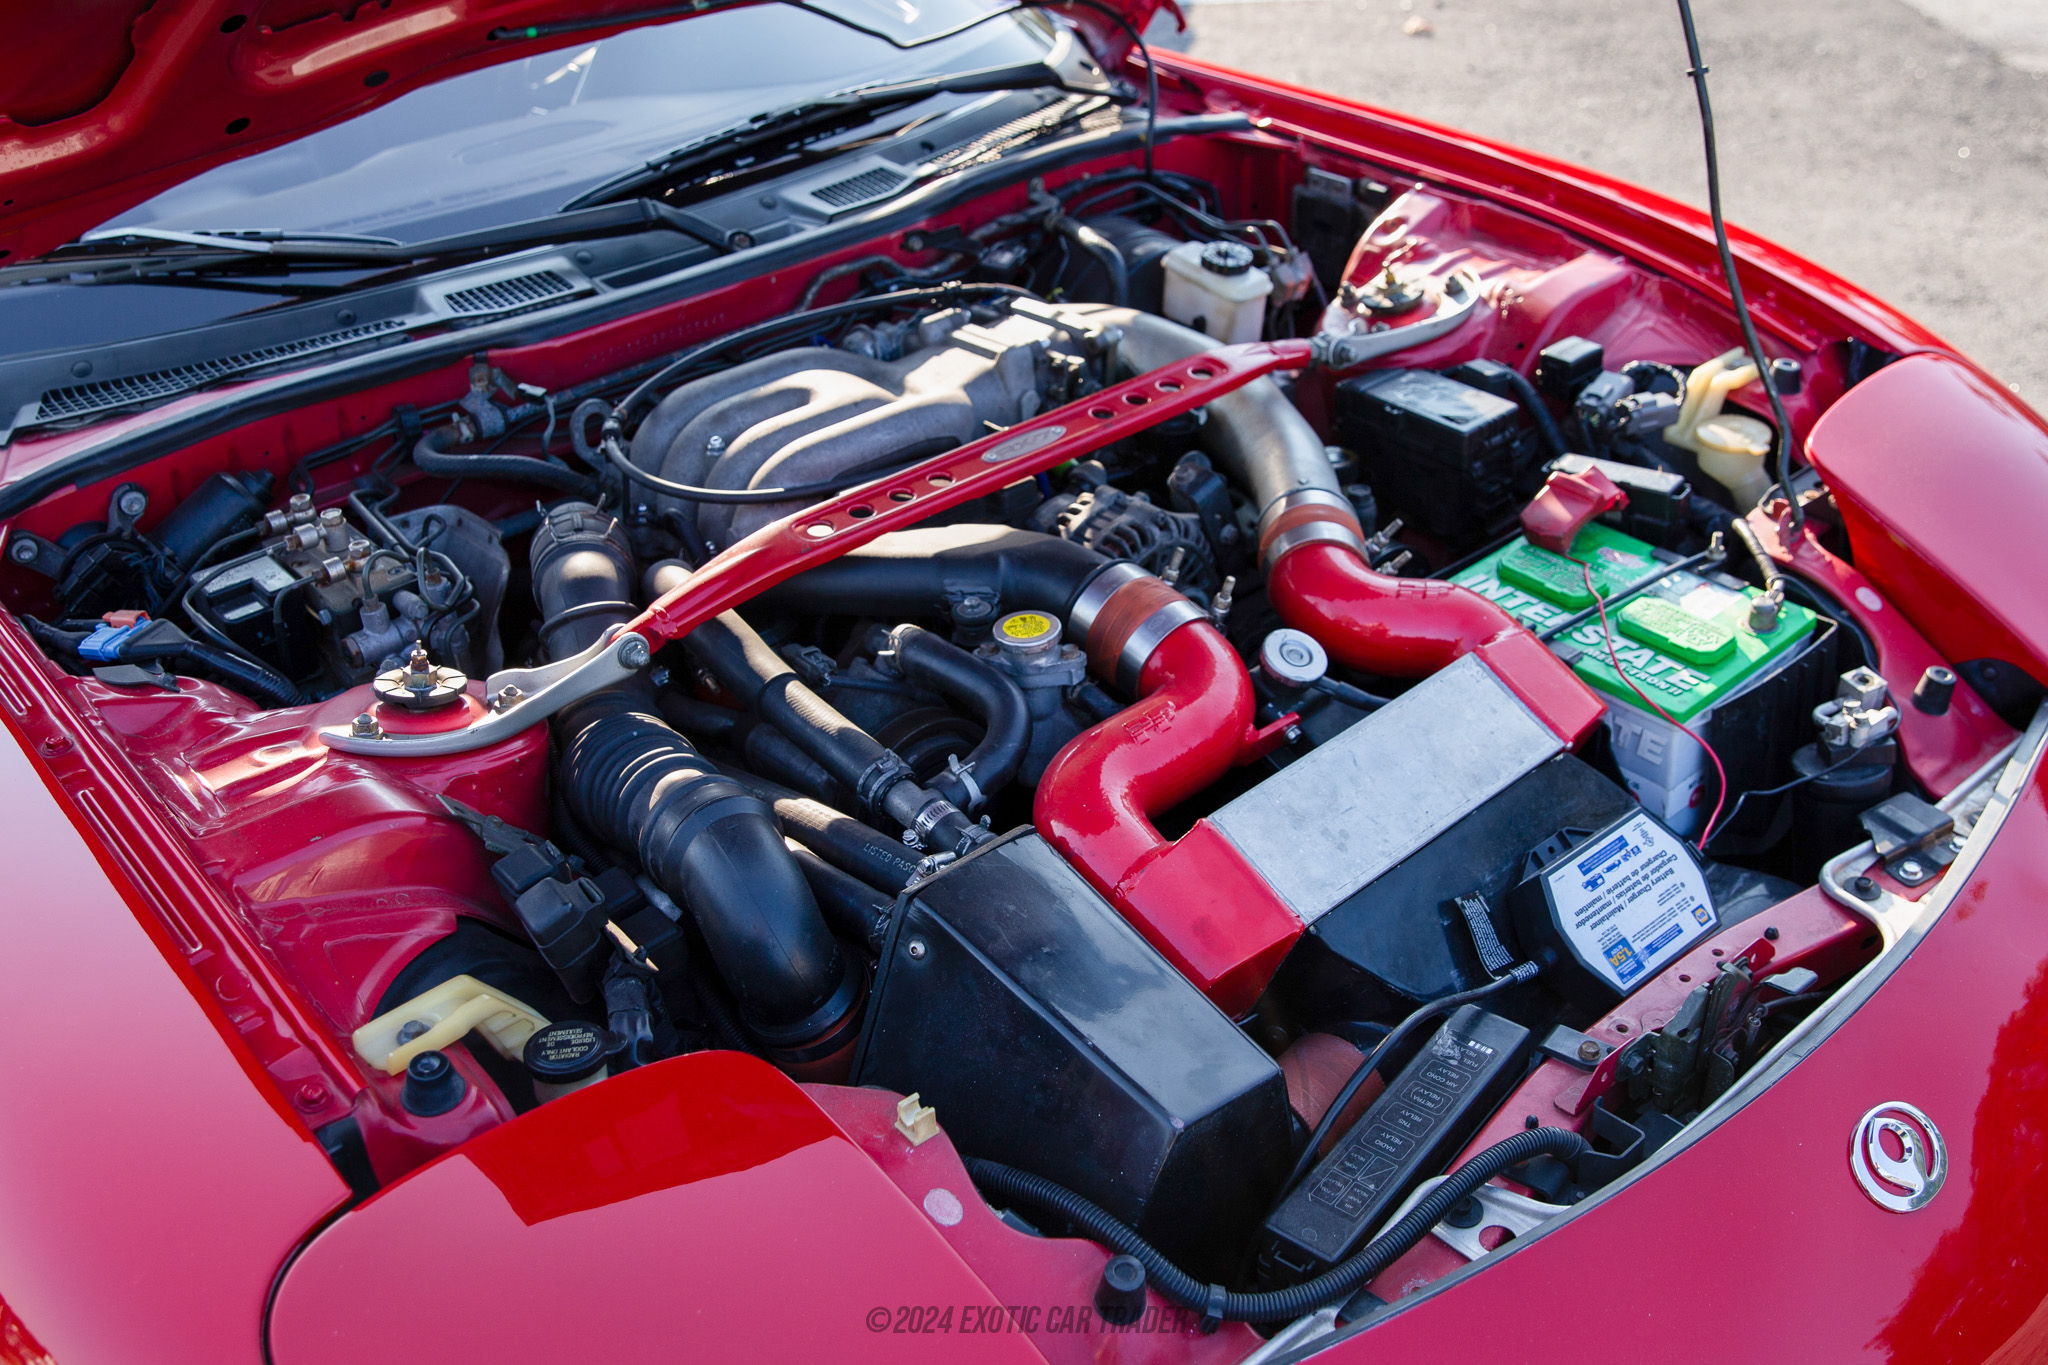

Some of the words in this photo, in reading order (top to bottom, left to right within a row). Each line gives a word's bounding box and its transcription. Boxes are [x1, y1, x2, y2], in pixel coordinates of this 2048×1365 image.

[863, 843, 893, 862] LISTED
[1640, 850, 1668, 871] Chargeur
[1650, 854, 1678, 876] Cargador
[1630, 869, 1640, 877] de
[1641, 873, 1650, 881] de
[1650, 868, 1675, 886] Battery
[1606, 875, 1632, 895] batterie
[1627, 884, 1652, 903] Charger
[1574, 895, 1603, 917] maintien
[1575, 900, 1613, 929] mantenedor
[1590, 903, 1625, 930] Maintainer
[1609, 947, 1633, 967] 1.5A
[548, 1028, 583, 1037] SEULEMENT
[571, 1037, 596, 1045] LIQUIDE
[560, 1045, 589, 1053] COOLANT
[549, 1052, 580, 1060] RADIATOR
[1463, 1058, 1479, 1068] FUEL
[1426, 1071, 1446, 1083] COND
[1438, 1067, 1459, 1079] RELAY
[1446, 1080, 1458, 1088] AIR
[1419, 1088, 1441, 1101] RELAY
[1413, 1095, 1435, 1109] RETRA
[1400, 1109, 1422, 1123] RELAY
[1397, 1118, 1411, 1128] TNS
[1380, 1132, 1403, 1145] RELAY
[1374, 1139, 1396, 1153] RADIO
[1351, 1153, 1366, 1162] RELAY
